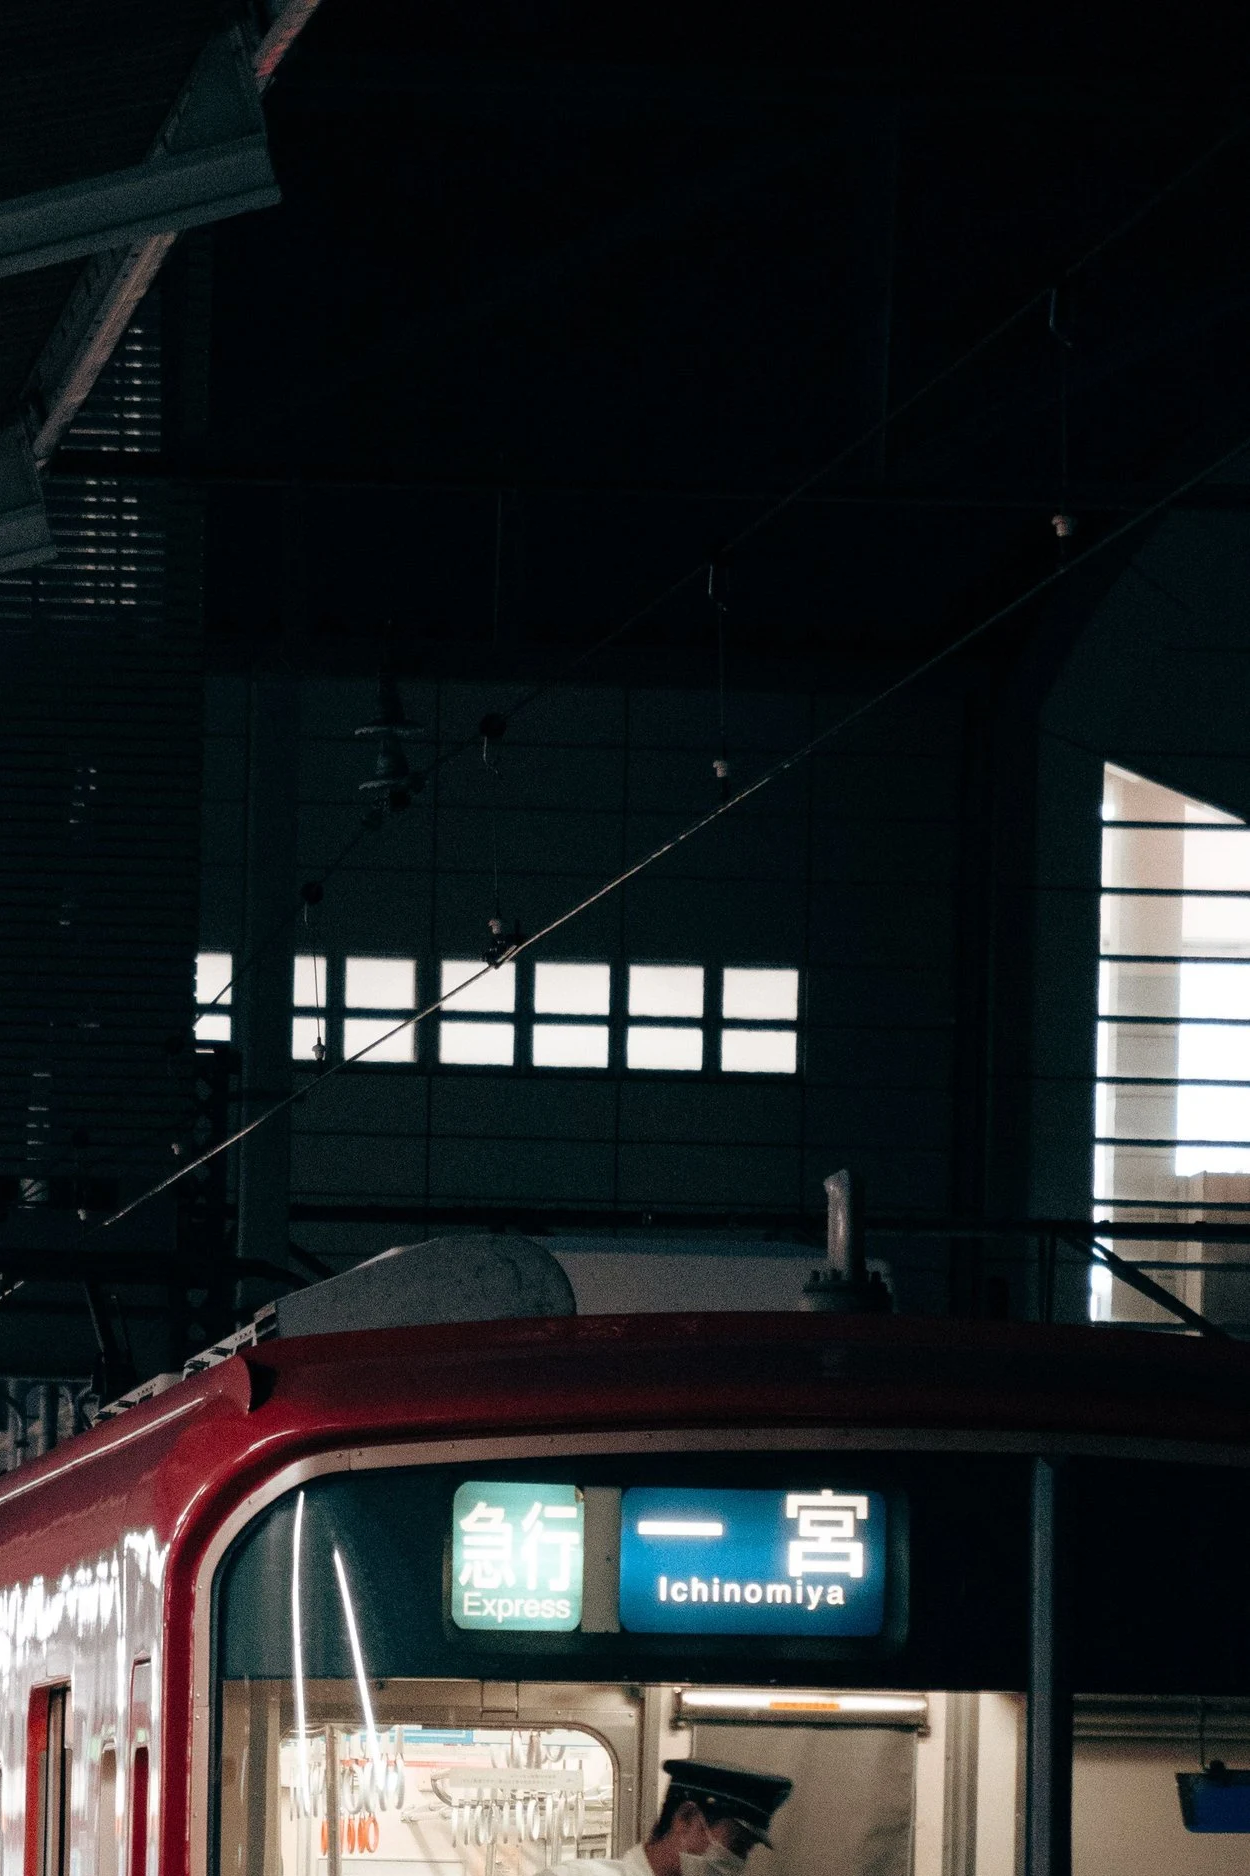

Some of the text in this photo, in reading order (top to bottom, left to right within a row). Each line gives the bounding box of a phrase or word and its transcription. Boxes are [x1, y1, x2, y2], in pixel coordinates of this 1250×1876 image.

[459, 1502, 580, 1591] 急行
[638, 1489, 868, 1578] 一宮
[463, 1592, 571, 1623] Express
[659, 1576, 845, 1610] Ichinomiya
